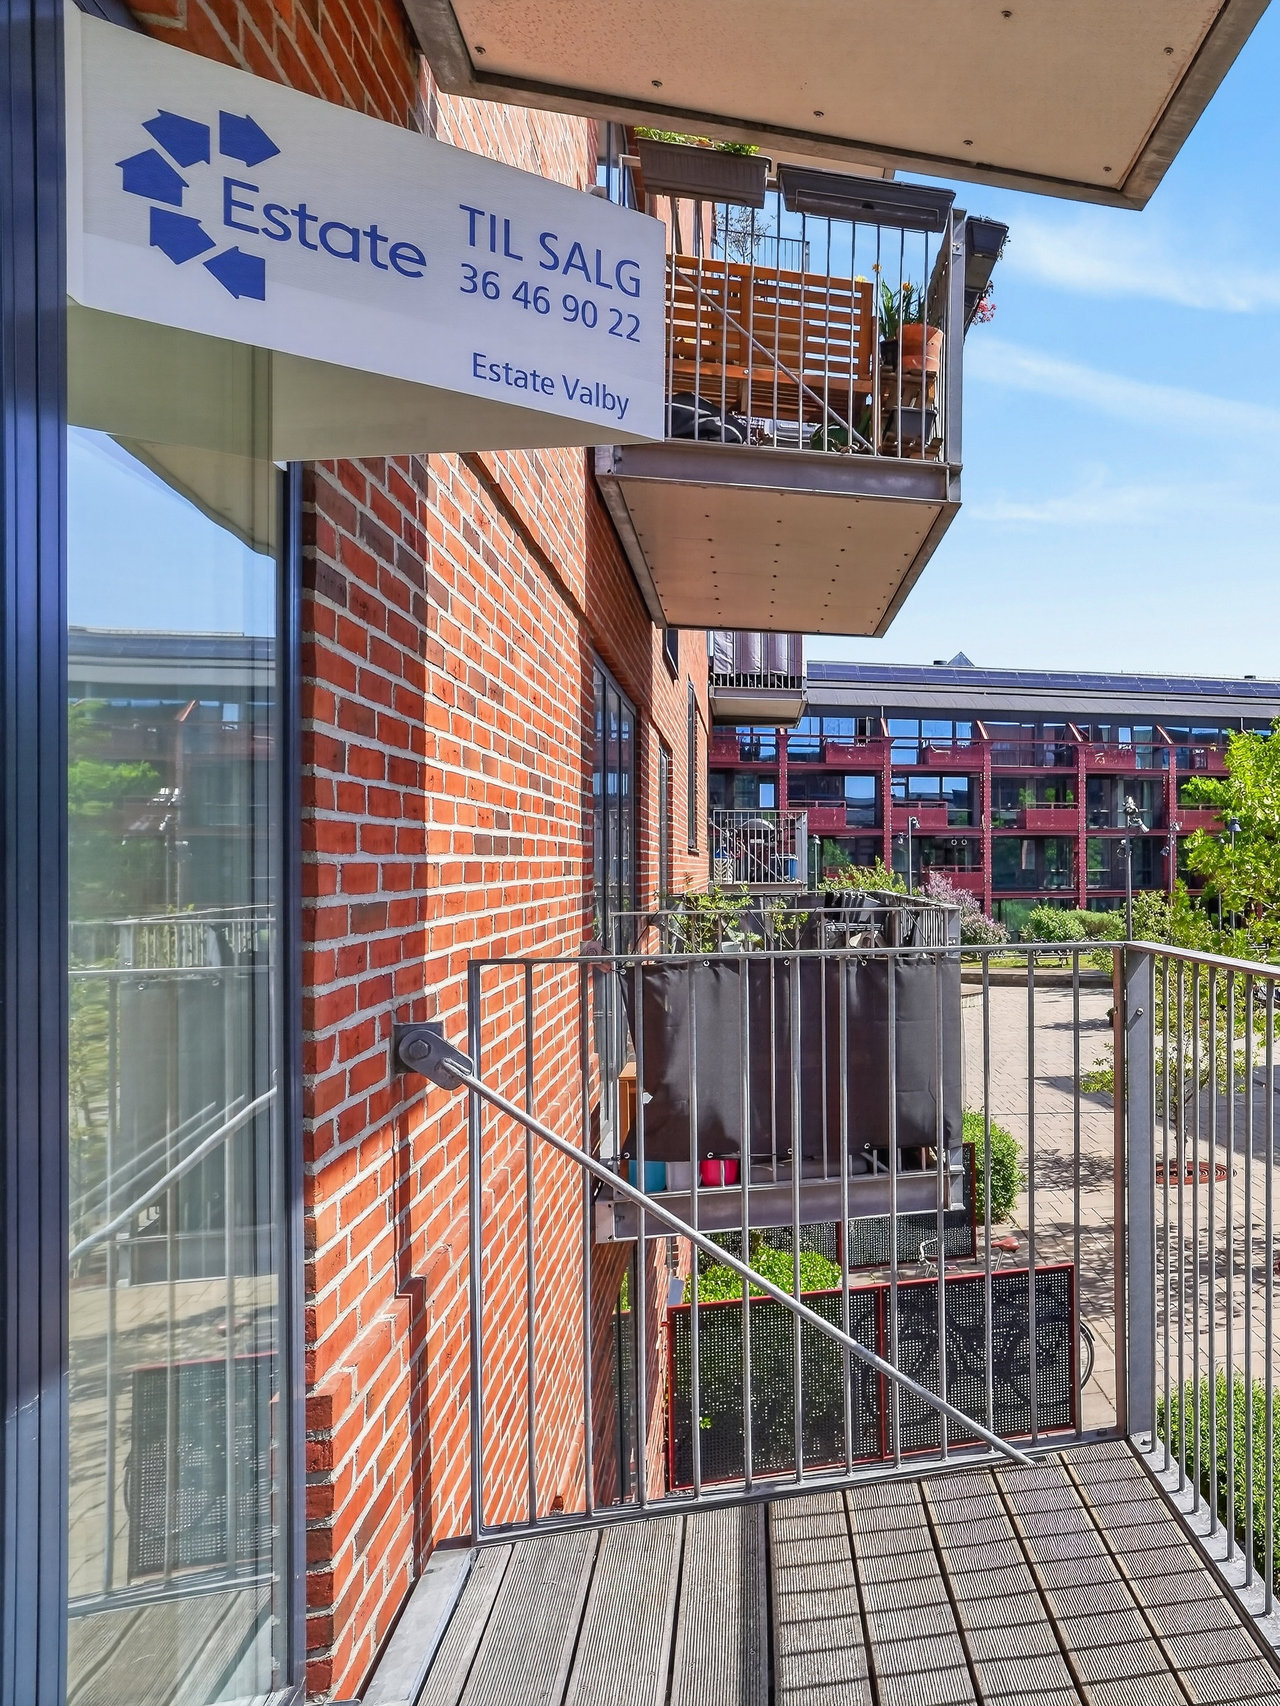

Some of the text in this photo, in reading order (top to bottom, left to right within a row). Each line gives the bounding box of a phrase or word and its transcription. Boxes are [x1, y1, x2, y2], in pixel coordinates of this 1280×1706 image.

[222, 176, 427, 280] Estate
[459, 204, 642, 299] TIL SALG
[459, 262, 642, 344] 36 46 90 22
[471, 351, 631, 421] Estate Valby
